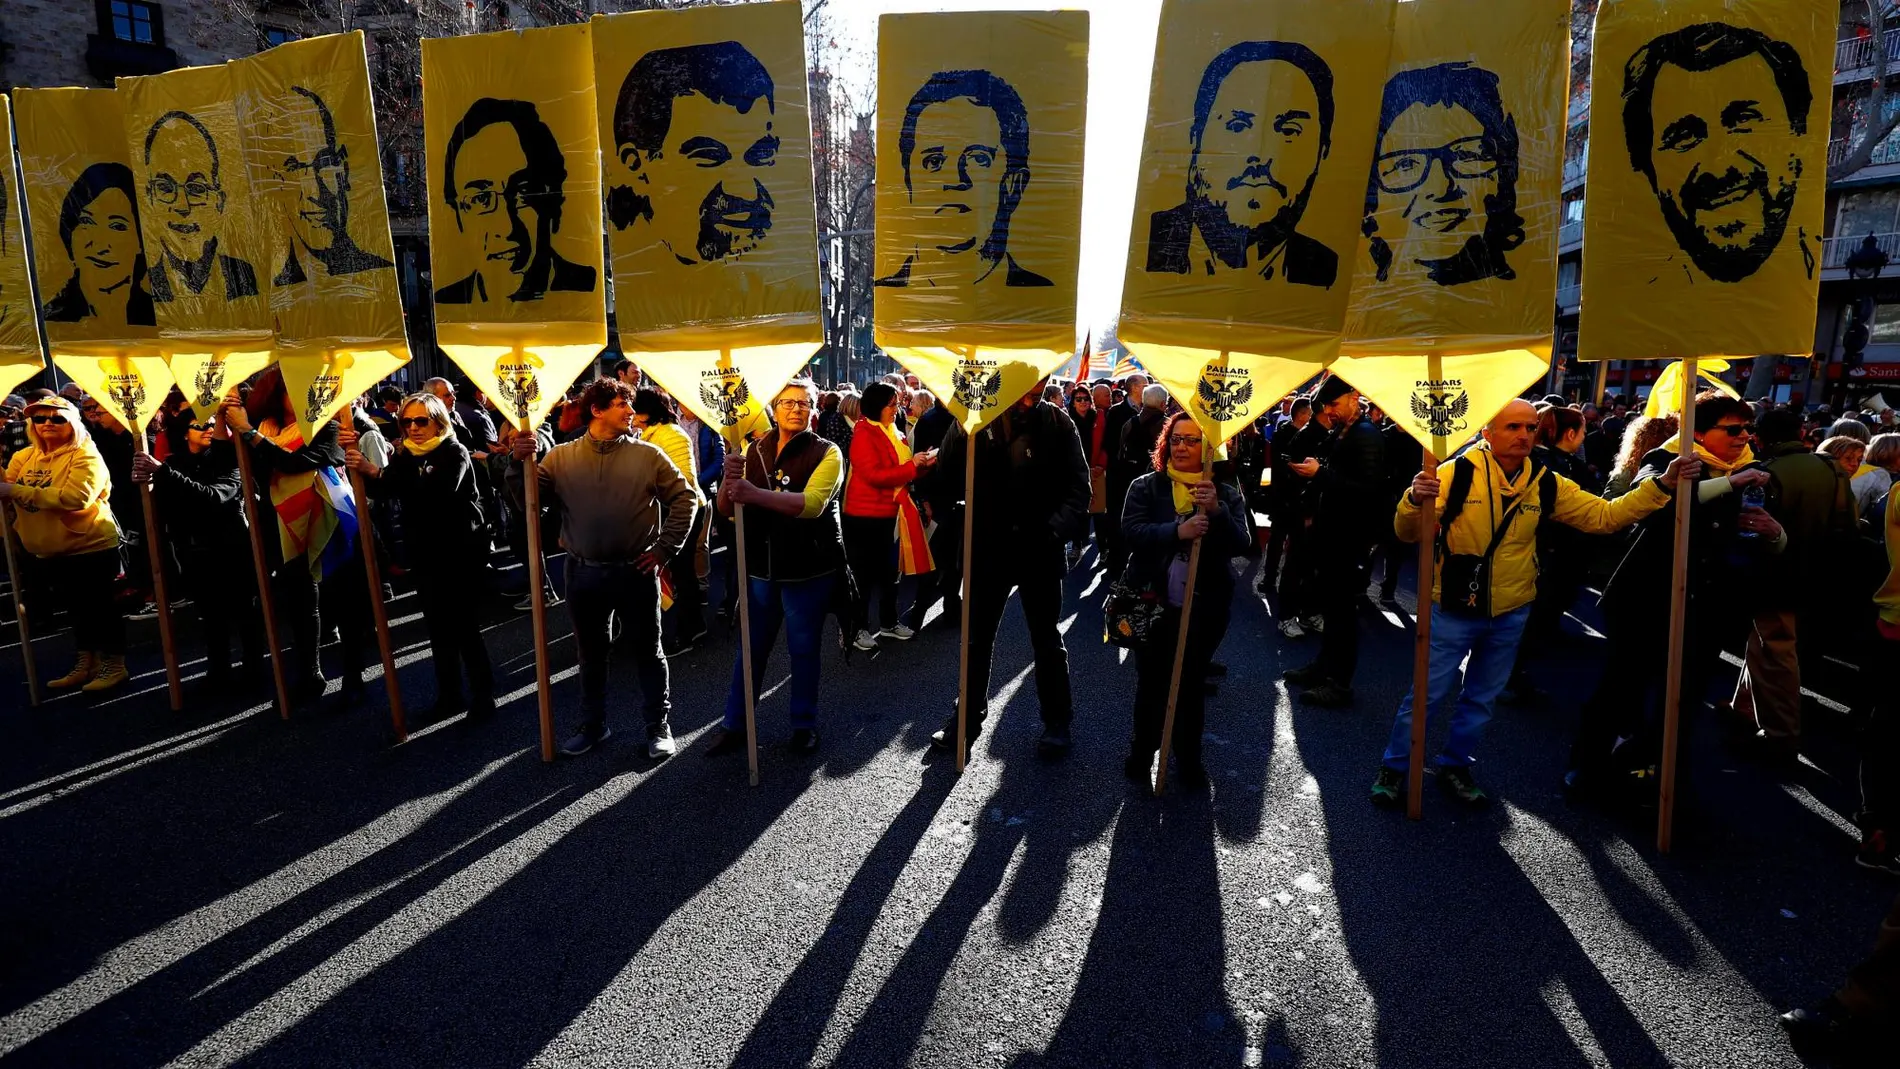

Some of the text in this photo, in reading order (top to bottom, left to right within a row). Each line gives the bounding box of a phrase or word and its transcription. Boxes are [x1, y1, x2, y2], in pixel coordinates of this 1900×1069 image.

[701, 366, 741, 377] PALLARS
[1206, 365, 1249, 375] PALLARS
[108, 373, 138, 381] PALLARS
[1415, 379, 1462, 387] PALLARS
